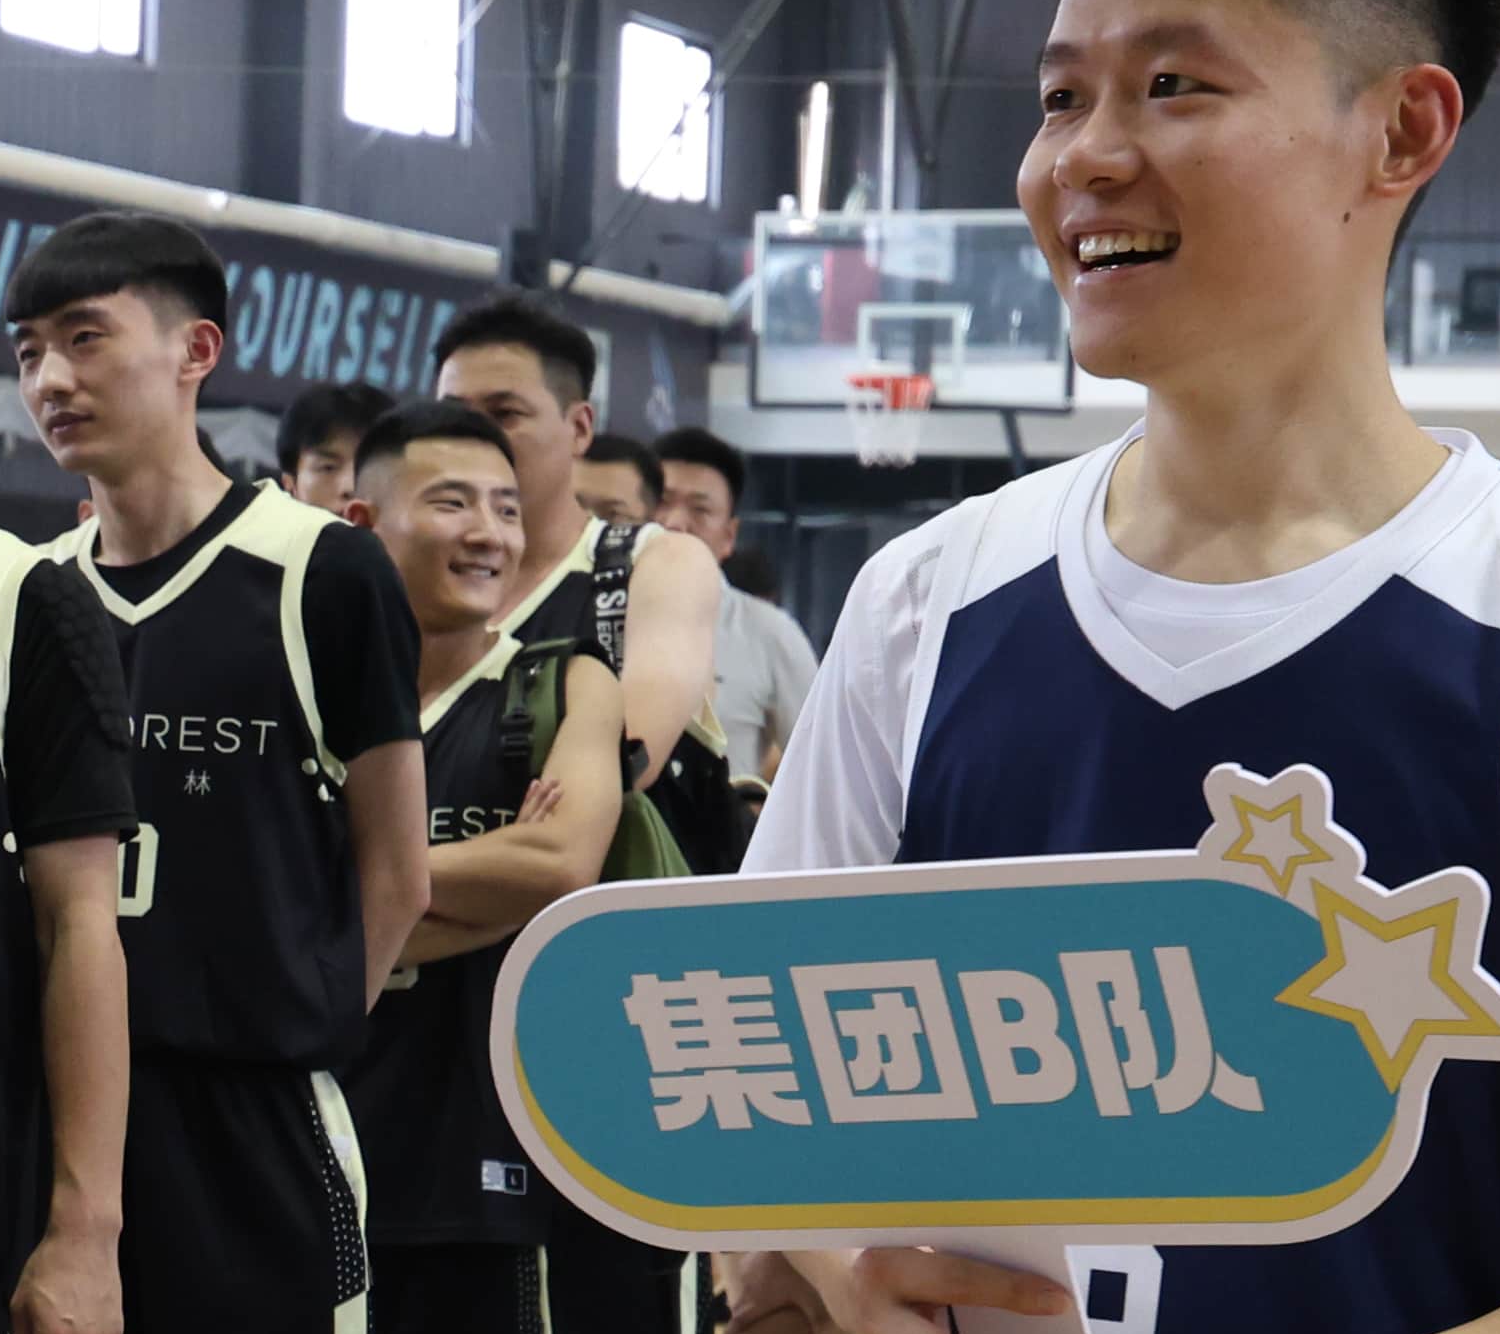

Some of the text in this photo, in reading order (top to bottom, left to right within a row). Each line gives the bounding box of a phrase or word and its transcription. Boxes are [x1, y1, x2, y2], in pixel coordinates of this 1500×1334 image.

[227, 262, 456, 394] OURSELF
[129, 713, 278, 755] REST
[623, 946, 1264, 1130] 集团B队
